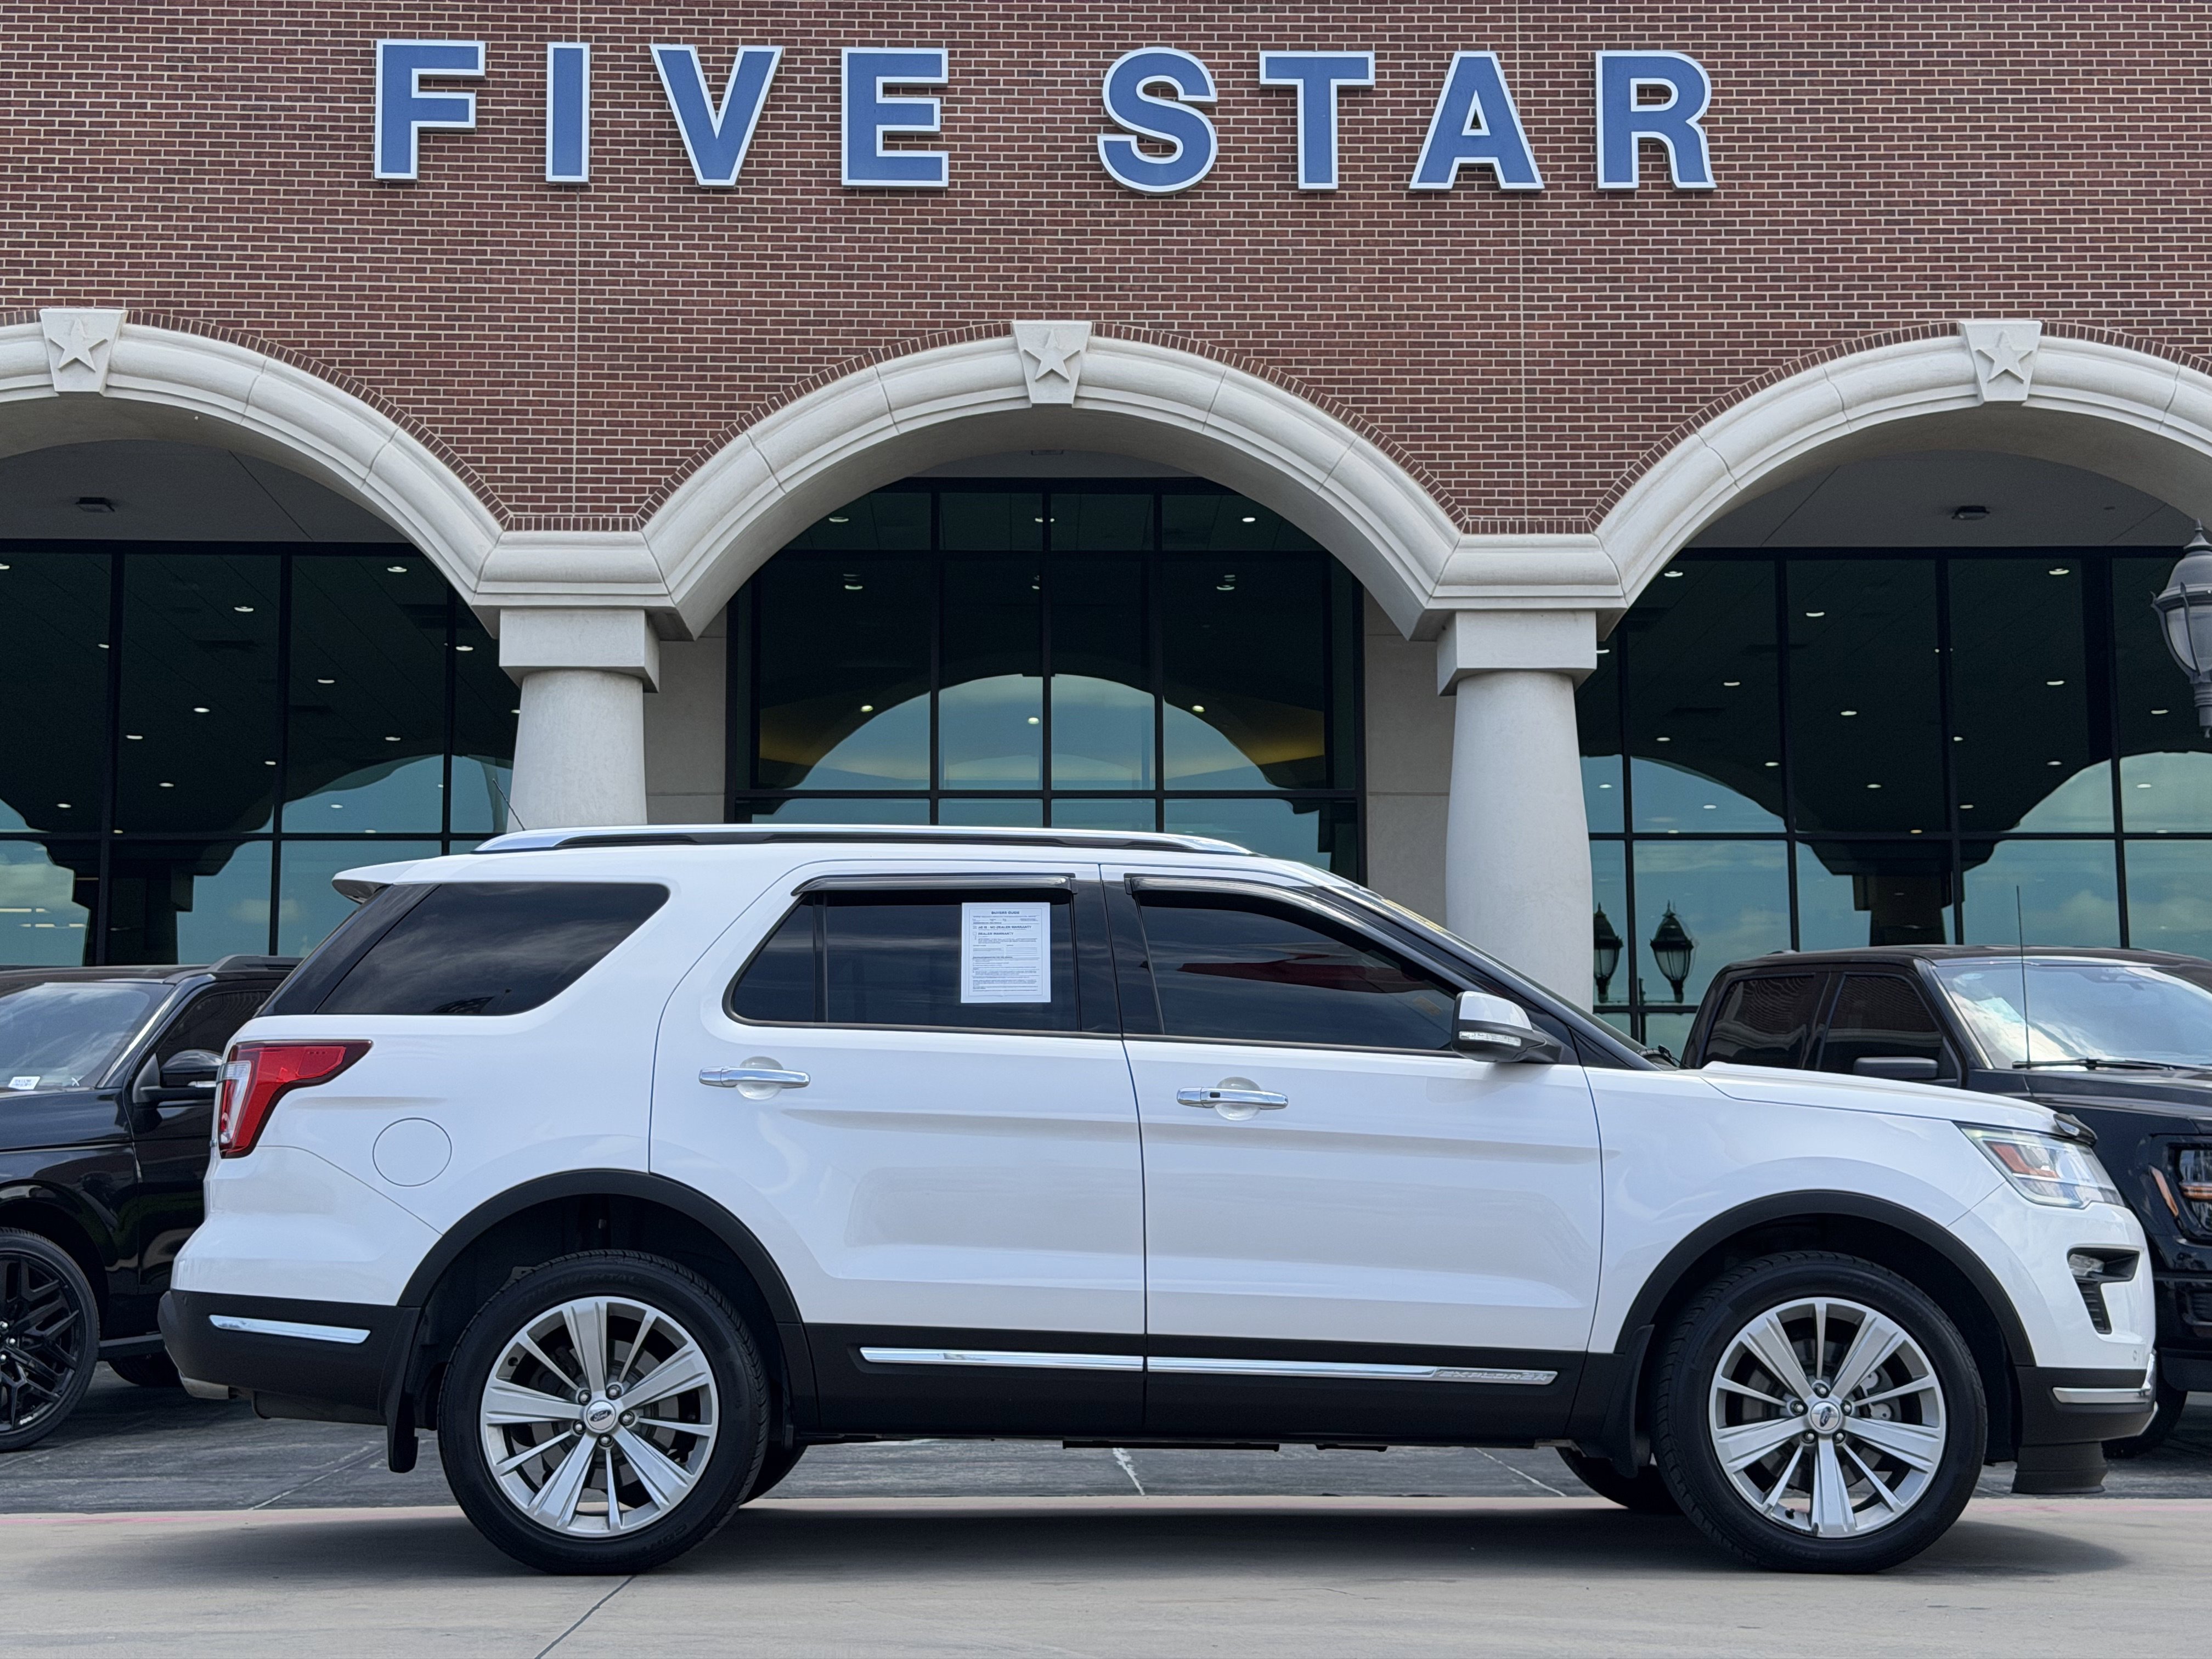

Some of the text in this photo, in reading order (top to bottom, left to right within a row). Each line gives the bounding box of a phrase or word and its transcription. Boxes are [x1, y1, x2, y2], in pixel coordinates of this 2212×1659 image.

[374, 40, 1717, 195] FIVE STAR
[1438, 1370, 1548, 1381] EXPLORER
